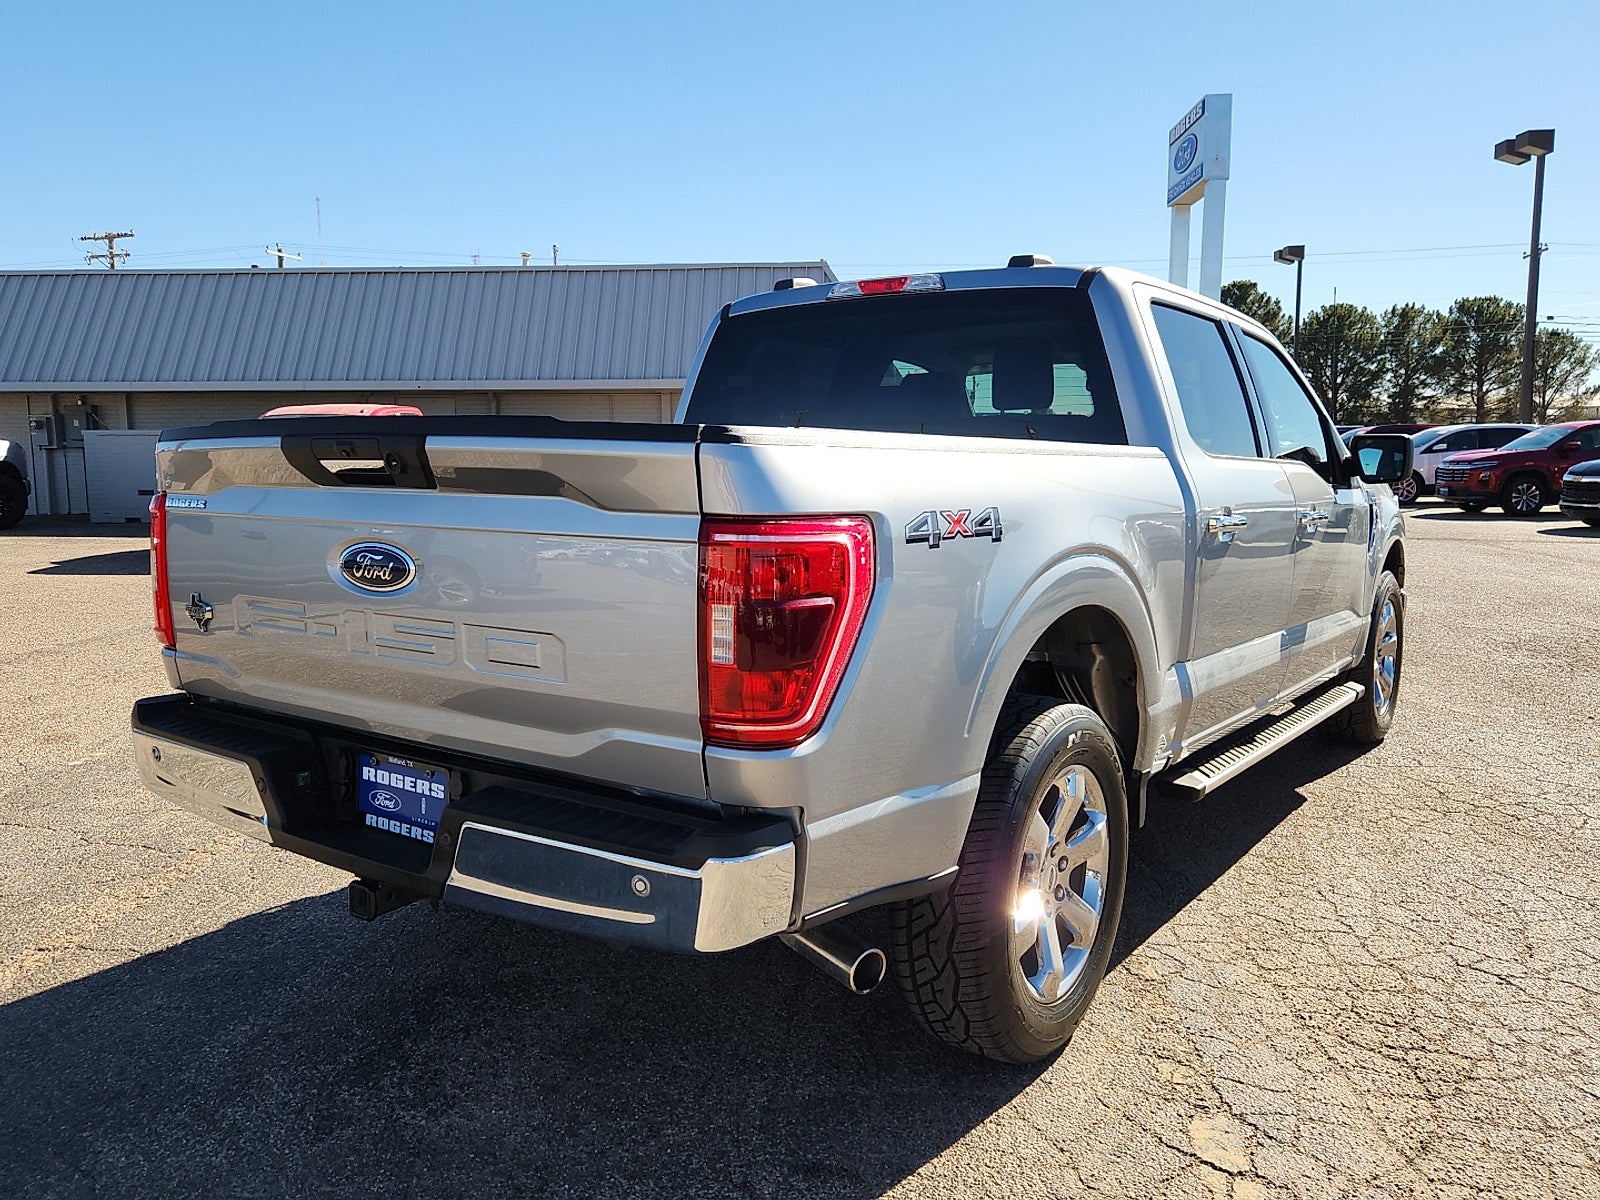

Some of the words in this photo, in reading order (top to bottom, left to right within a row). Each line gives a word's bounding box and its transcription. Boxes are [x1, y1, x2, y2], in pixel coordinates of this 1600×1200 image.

[166, 499, 207, 508] ROGERS
[353, 551, 393, 582] Ford
[233, 594, 566, 684] F-150
[362, 766, 445, 799] ROGERS
[374, 792, 396, 809] Ford
[365, 813, 434, 844] ROGERS
